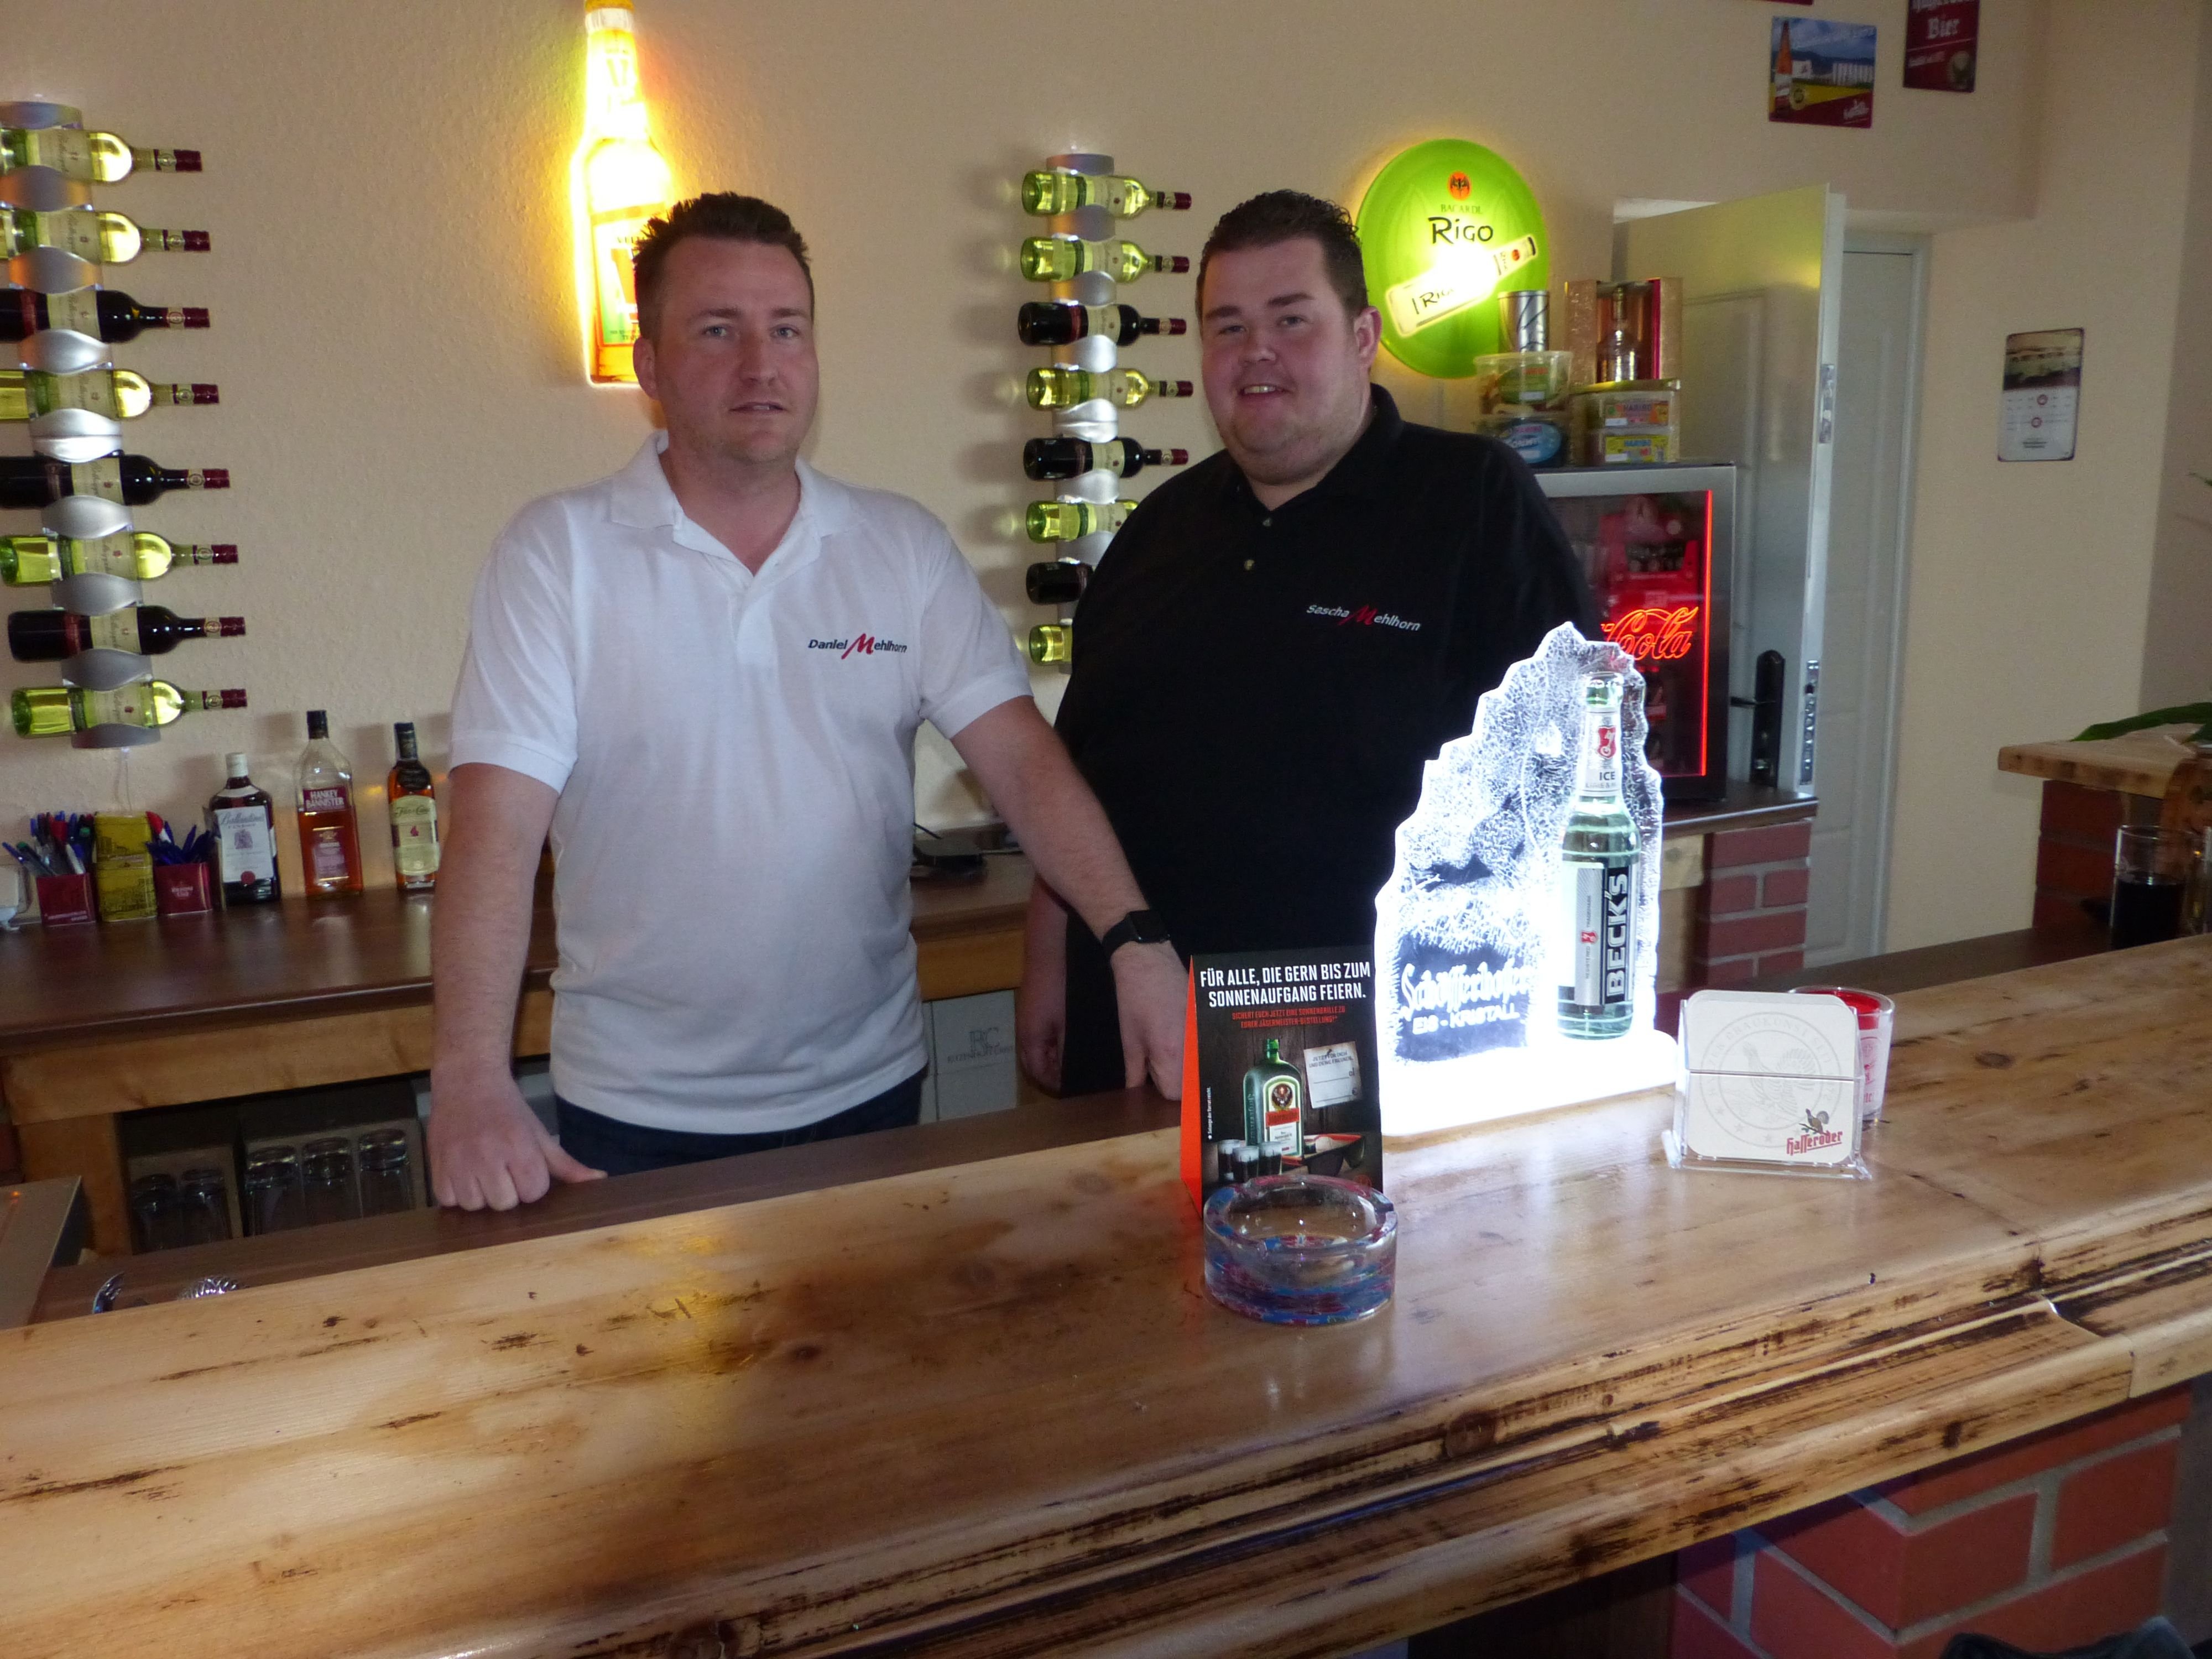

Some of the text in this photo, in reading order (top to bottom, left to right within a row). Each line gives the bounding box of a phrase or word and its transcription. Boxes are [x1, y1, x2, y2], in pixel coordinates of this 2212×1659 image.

[1306, 604, 1421, 632] Sascha Mehlhorn
[808, 633, 907, 660] Daniel Mehlhorn
[1599, 771, 1615, 781] ICE
[305, 797, 345, 808] BANNISTER
[310, 790, 338, 799] HANKEY
[1604, 873, 1628, 997] BECK'S
[1200, 962, 1370, 987] FÜR ALLE, DIE GERN BIS ZUM
[1208, 982, 1366, 1008] SONNENAUFGANG FEIERN.
[1270, 1009, 1285, 1018] JETZT
